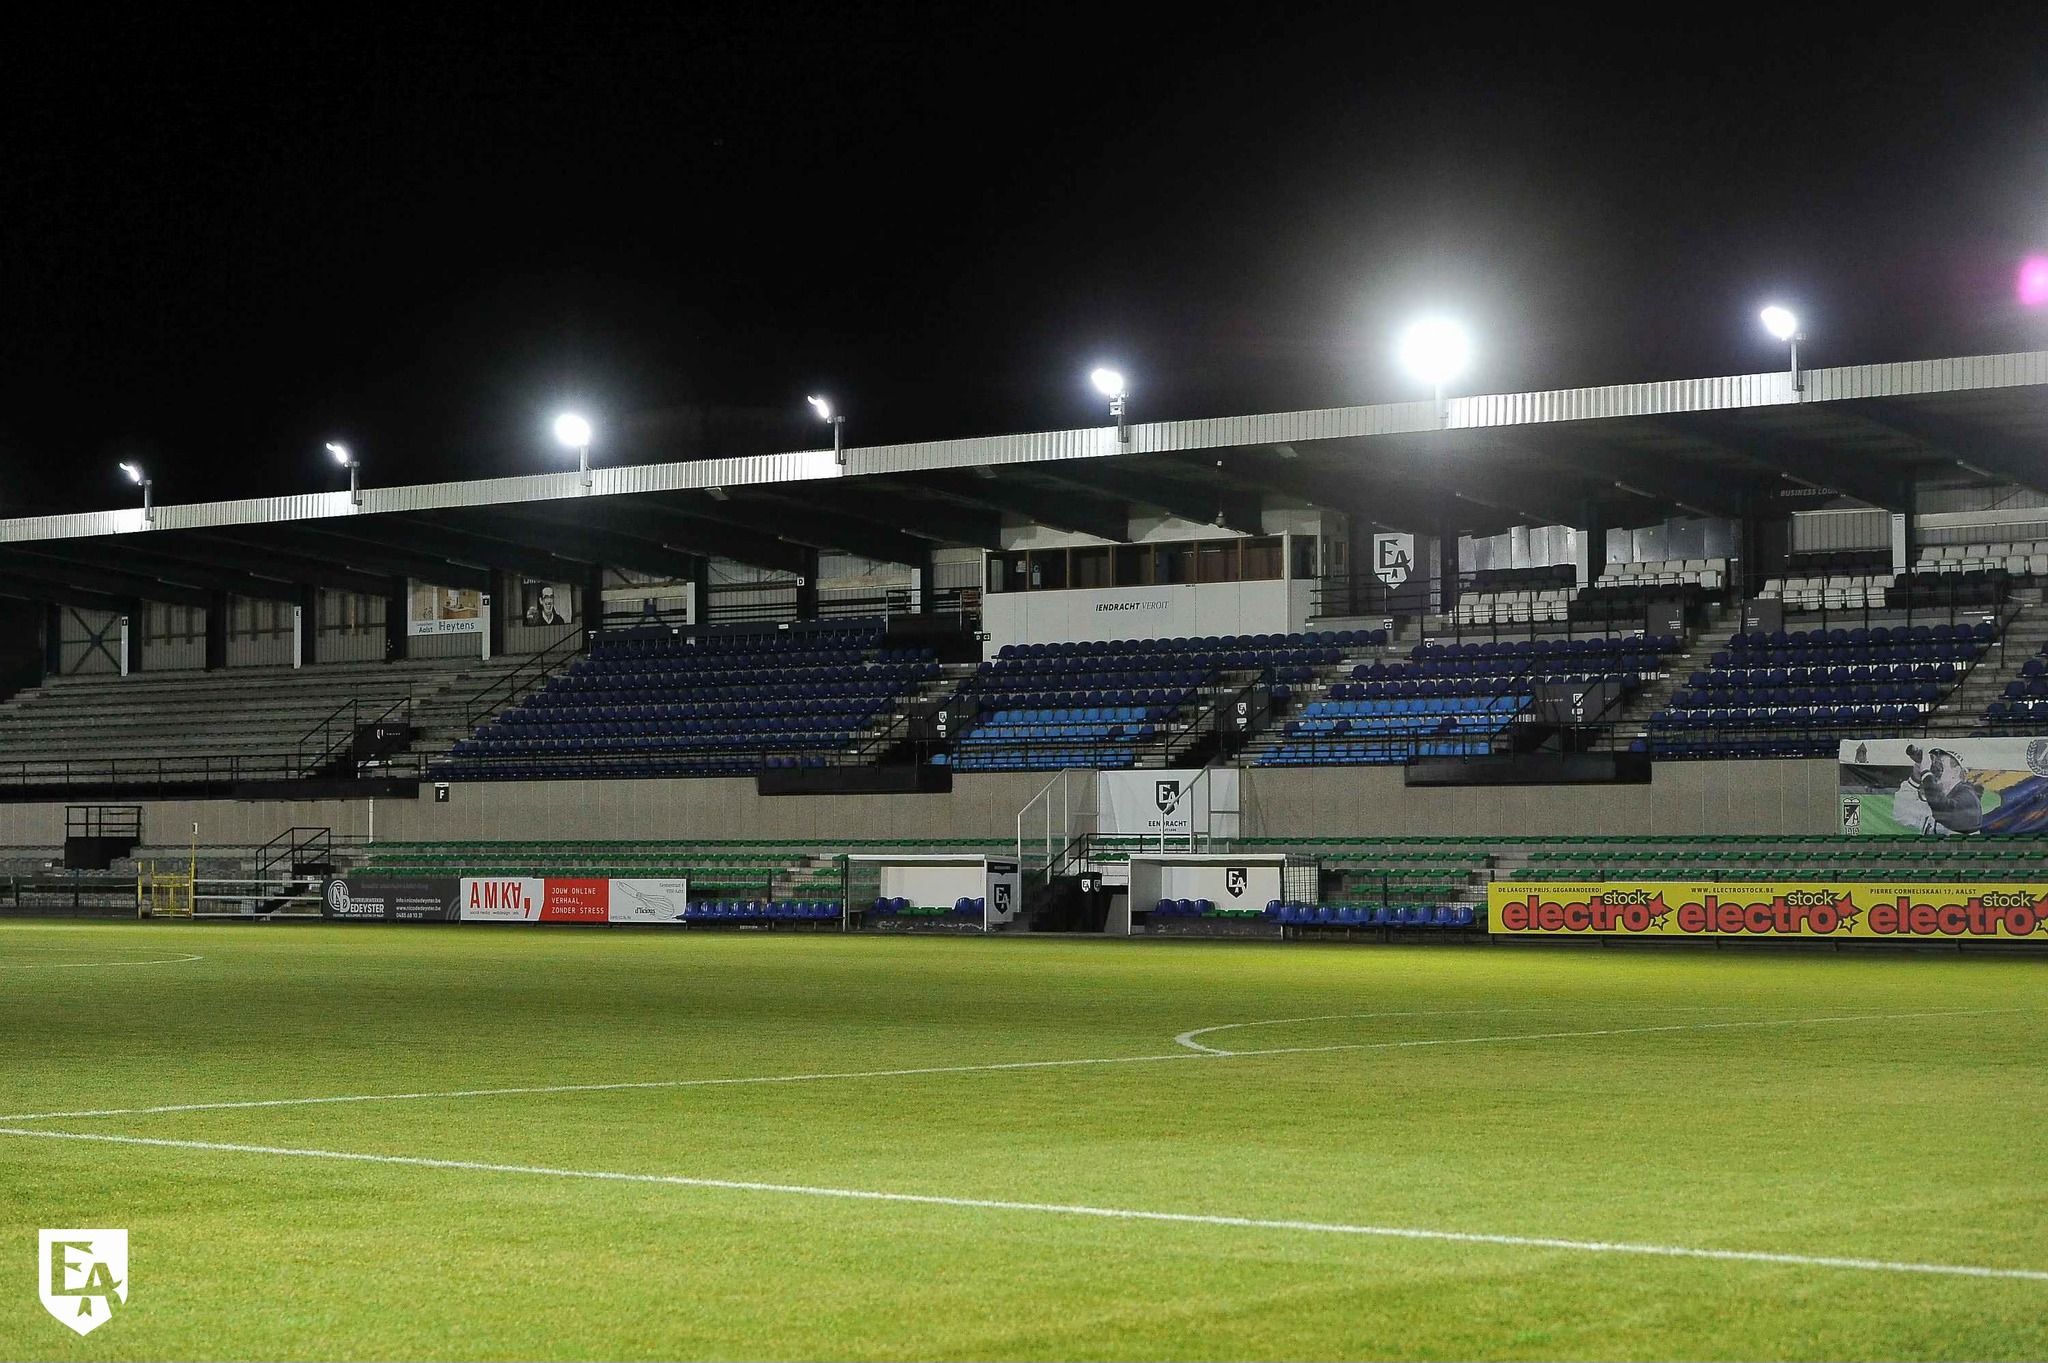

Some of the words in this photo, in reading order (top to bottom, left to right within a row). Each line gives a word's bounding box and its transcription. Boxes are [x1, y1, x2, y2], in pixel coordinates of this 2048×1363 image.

[1095, 602, 1141, 612] IENDRACHT
[438, 621, 475, 632] Heytens
[551, 887, 569, 895] JOUW
[571, 887, 596, 895] ONLINE
[1603, 890, 1647, 905] stock
[1787, 890, 1834, 906] stock
[551, 897, 584, 906] VERHAAL,
[1982, 891, 2031, 907] stock
[579, 907, 605, 915] STRESS
[1501, 895, 1650, 931] electro
[1677, 895, 1839, 934] electro
[1868, 895, 2037, 936] electro
